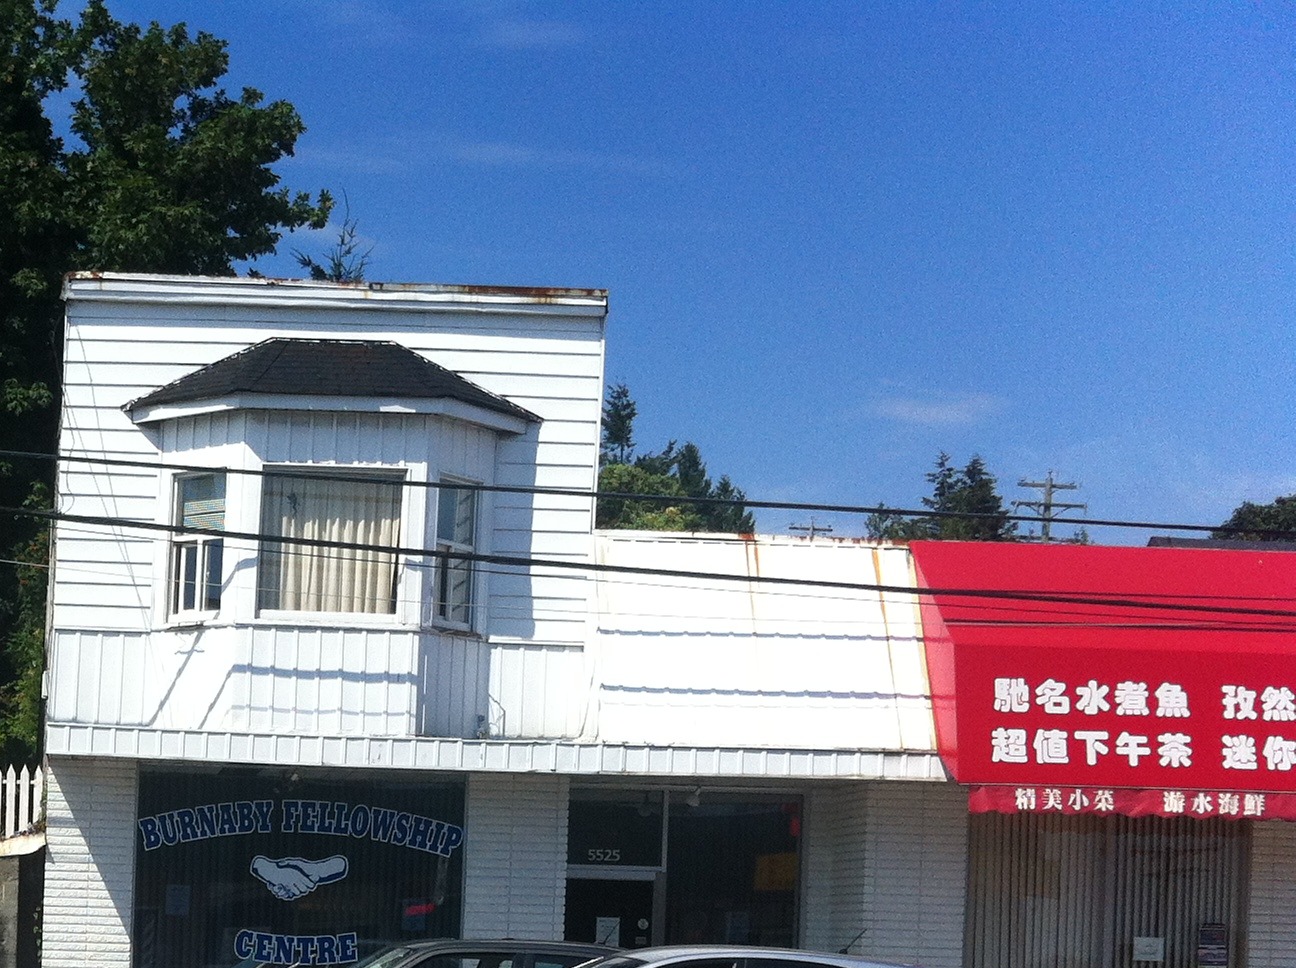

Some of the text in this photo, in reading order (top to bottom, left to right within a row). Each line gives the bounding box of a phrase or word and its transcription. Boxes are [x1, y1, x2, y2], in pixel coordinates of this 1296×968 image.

[993, 677, 1191, 717] 馳名水煮魚
[991, 727, 1193, 768] 超值下午茶
[138, 800, 464, 858] BURNABY FELLOWSHIP
[587, 849, 621, 861] 5525
[234, 929, 358, 966] CENTRE
